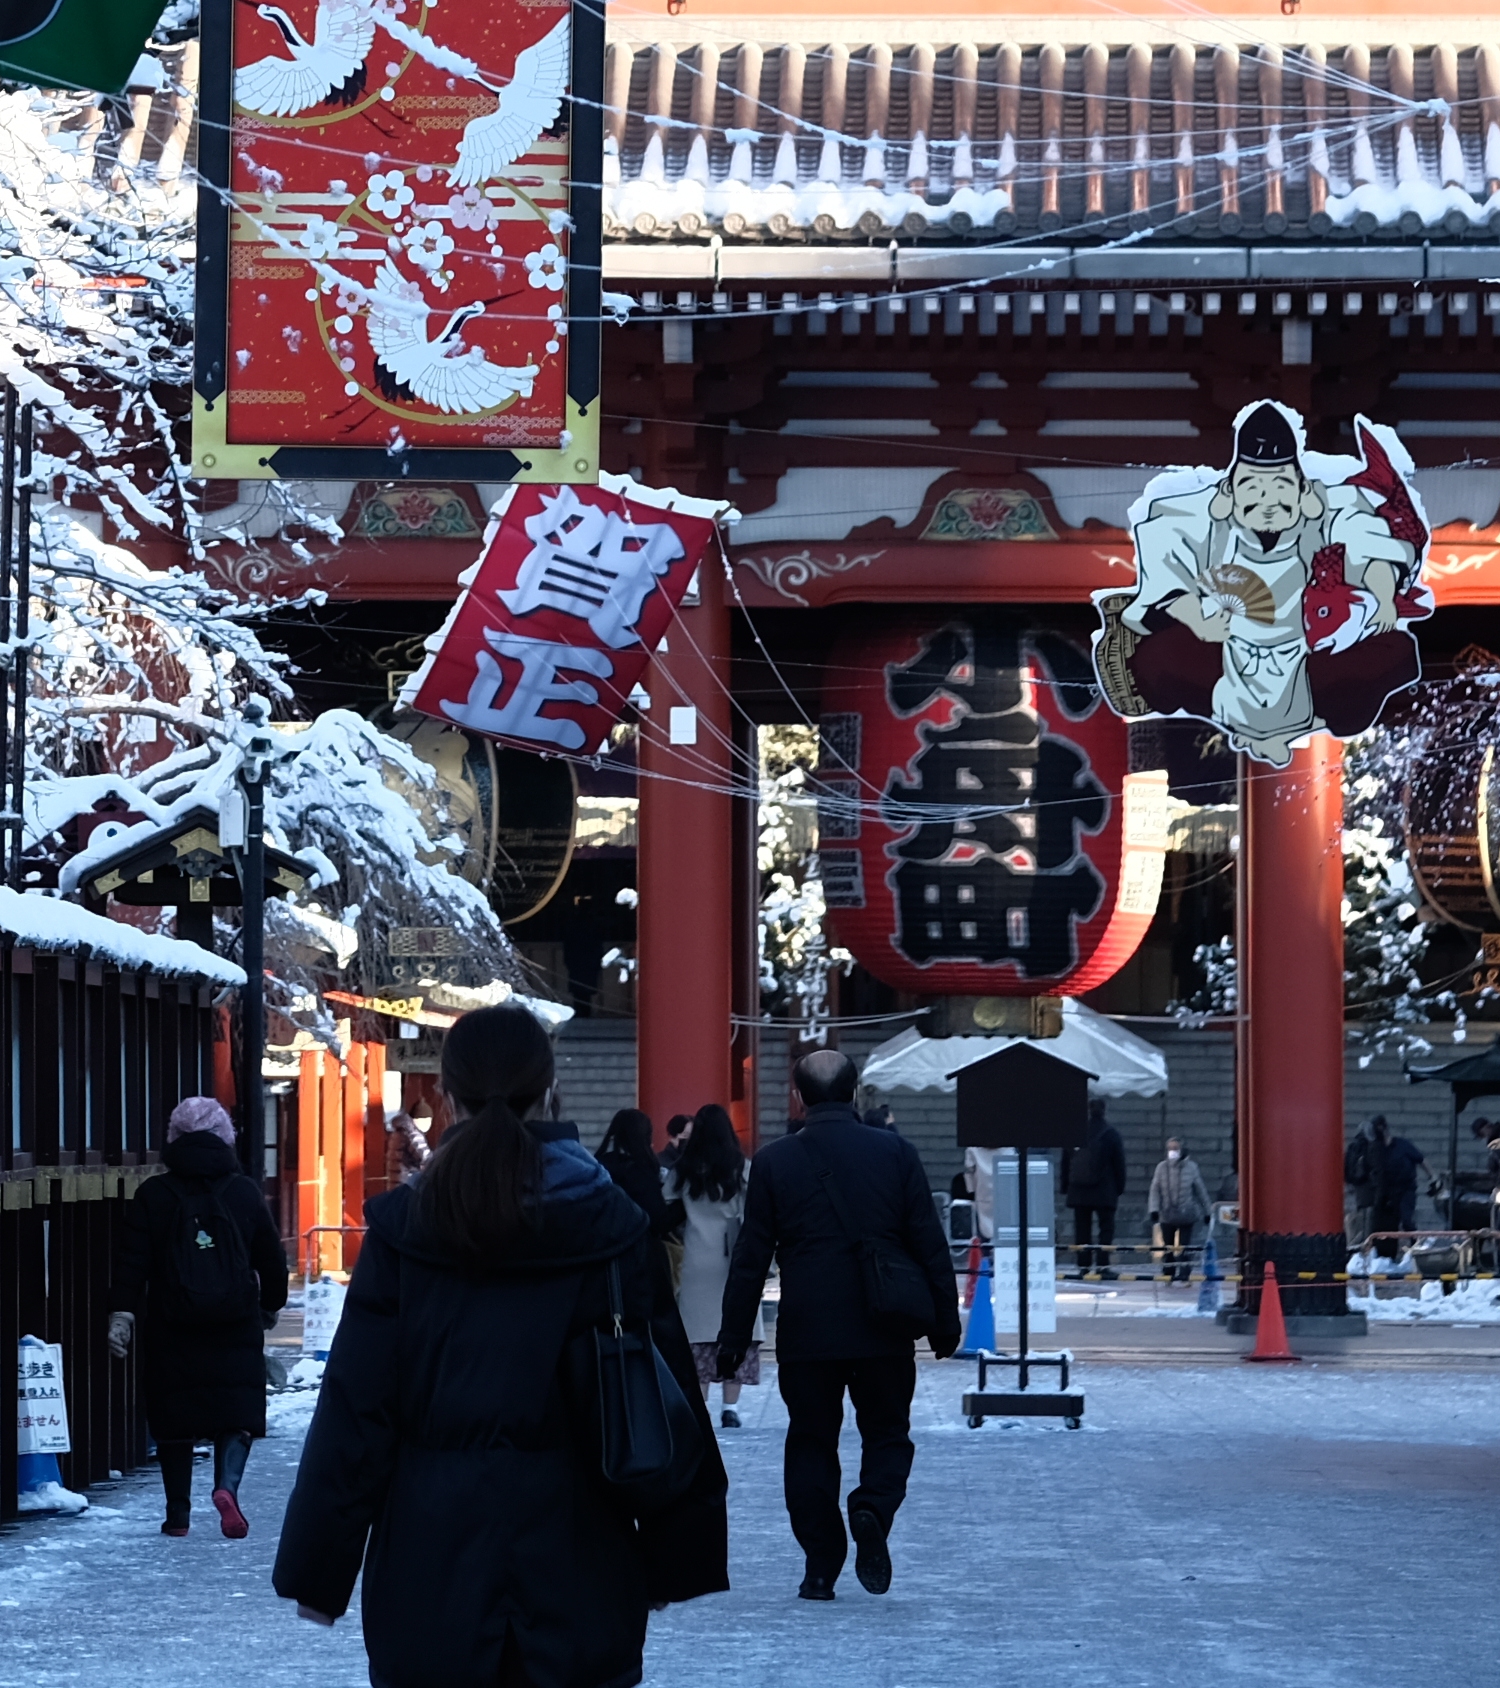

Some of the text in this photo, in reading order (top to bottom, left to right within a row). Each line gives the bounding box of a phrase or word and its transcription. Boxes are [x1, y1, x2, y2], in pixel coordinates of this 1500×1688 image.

[438, 484, 686, 751] 賀正
[879, 618, 1111, 980] 小舟町
